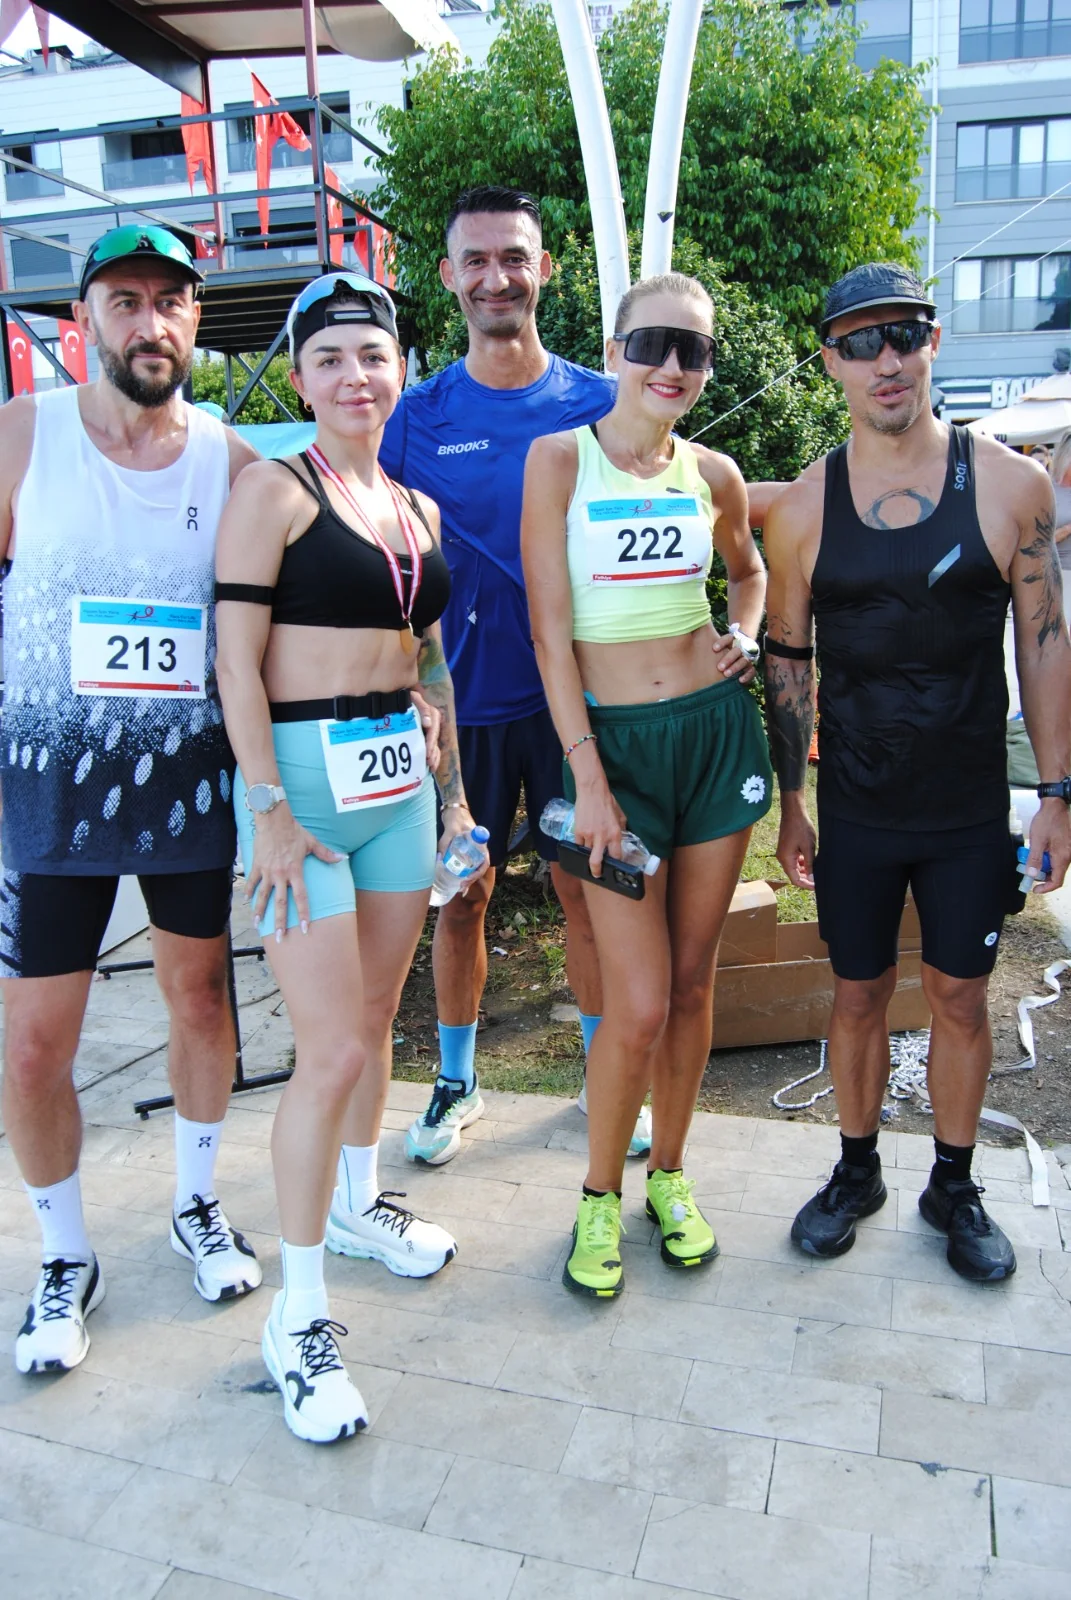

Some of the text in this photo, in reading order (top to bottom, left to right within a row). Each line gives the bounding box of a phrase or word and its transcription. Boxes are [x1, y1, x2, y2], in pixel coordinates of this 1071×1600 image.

[437, 439, 490, 455] BROOKS
[954, 461, 967, 491] soar
[617, 525, 684, 562] 222
[106, 634, 177, 672] 213
[358, 742, 412, 783] 209
